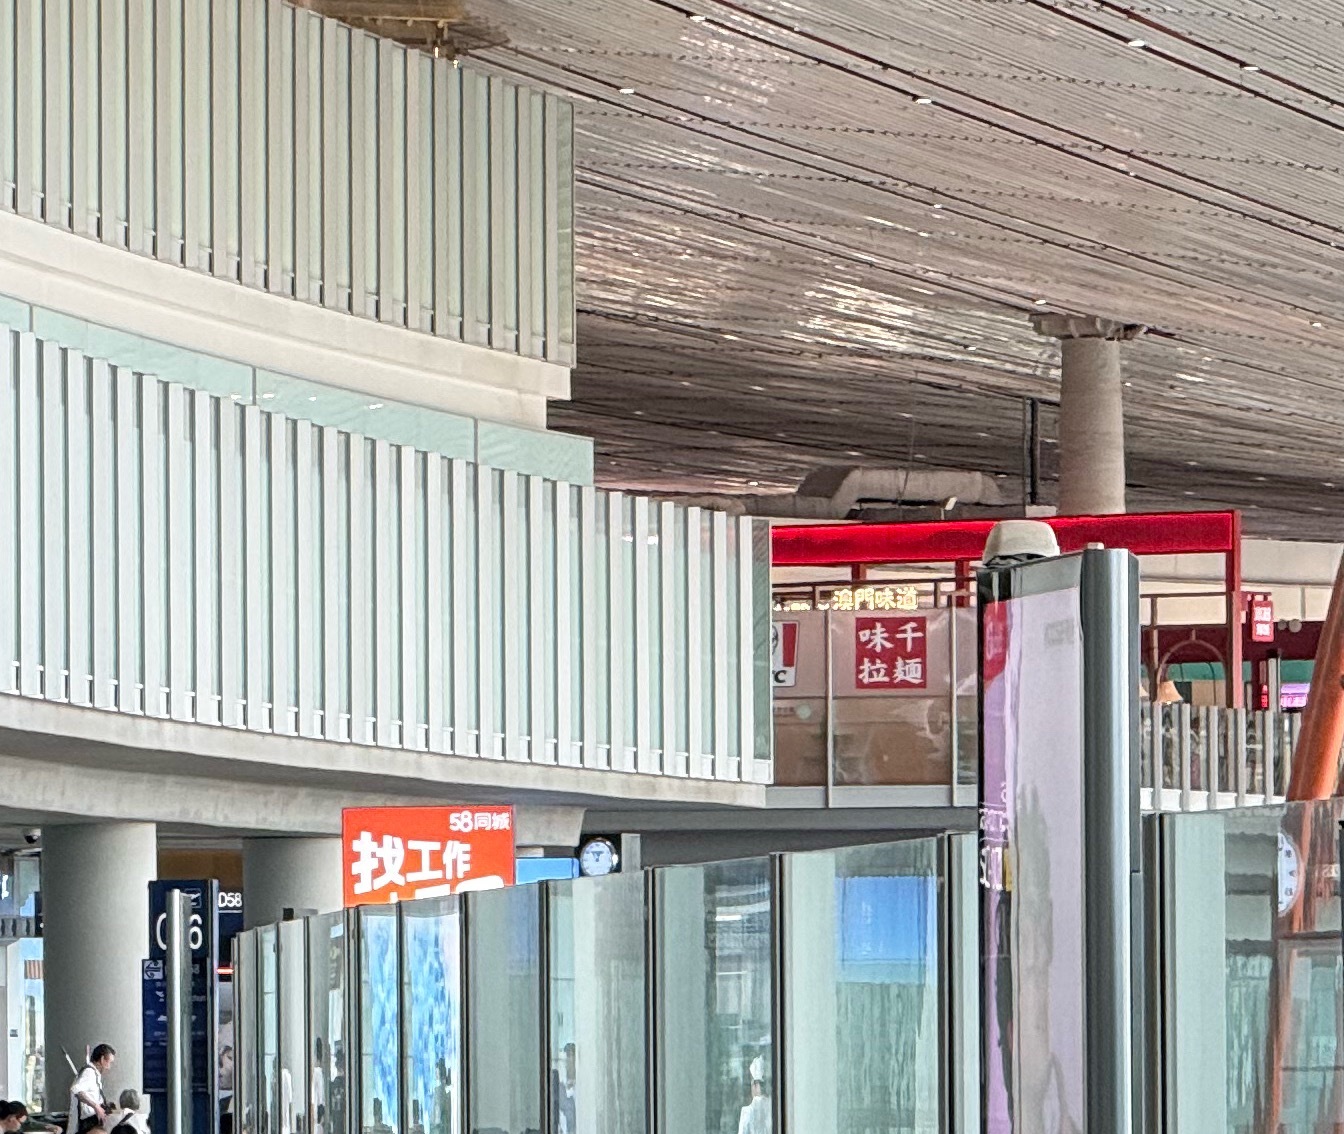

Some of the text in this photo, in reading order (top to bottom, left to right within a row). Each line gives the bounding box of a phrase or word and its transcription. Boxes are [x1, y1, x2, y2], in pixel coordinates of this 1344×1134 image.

[833, 587, 919, 611] 澳門味道
[858, 621, 924, 653] 味千
[449, 810, 511, 833] 58同城
[351, 830, 471, 895] 找工作
